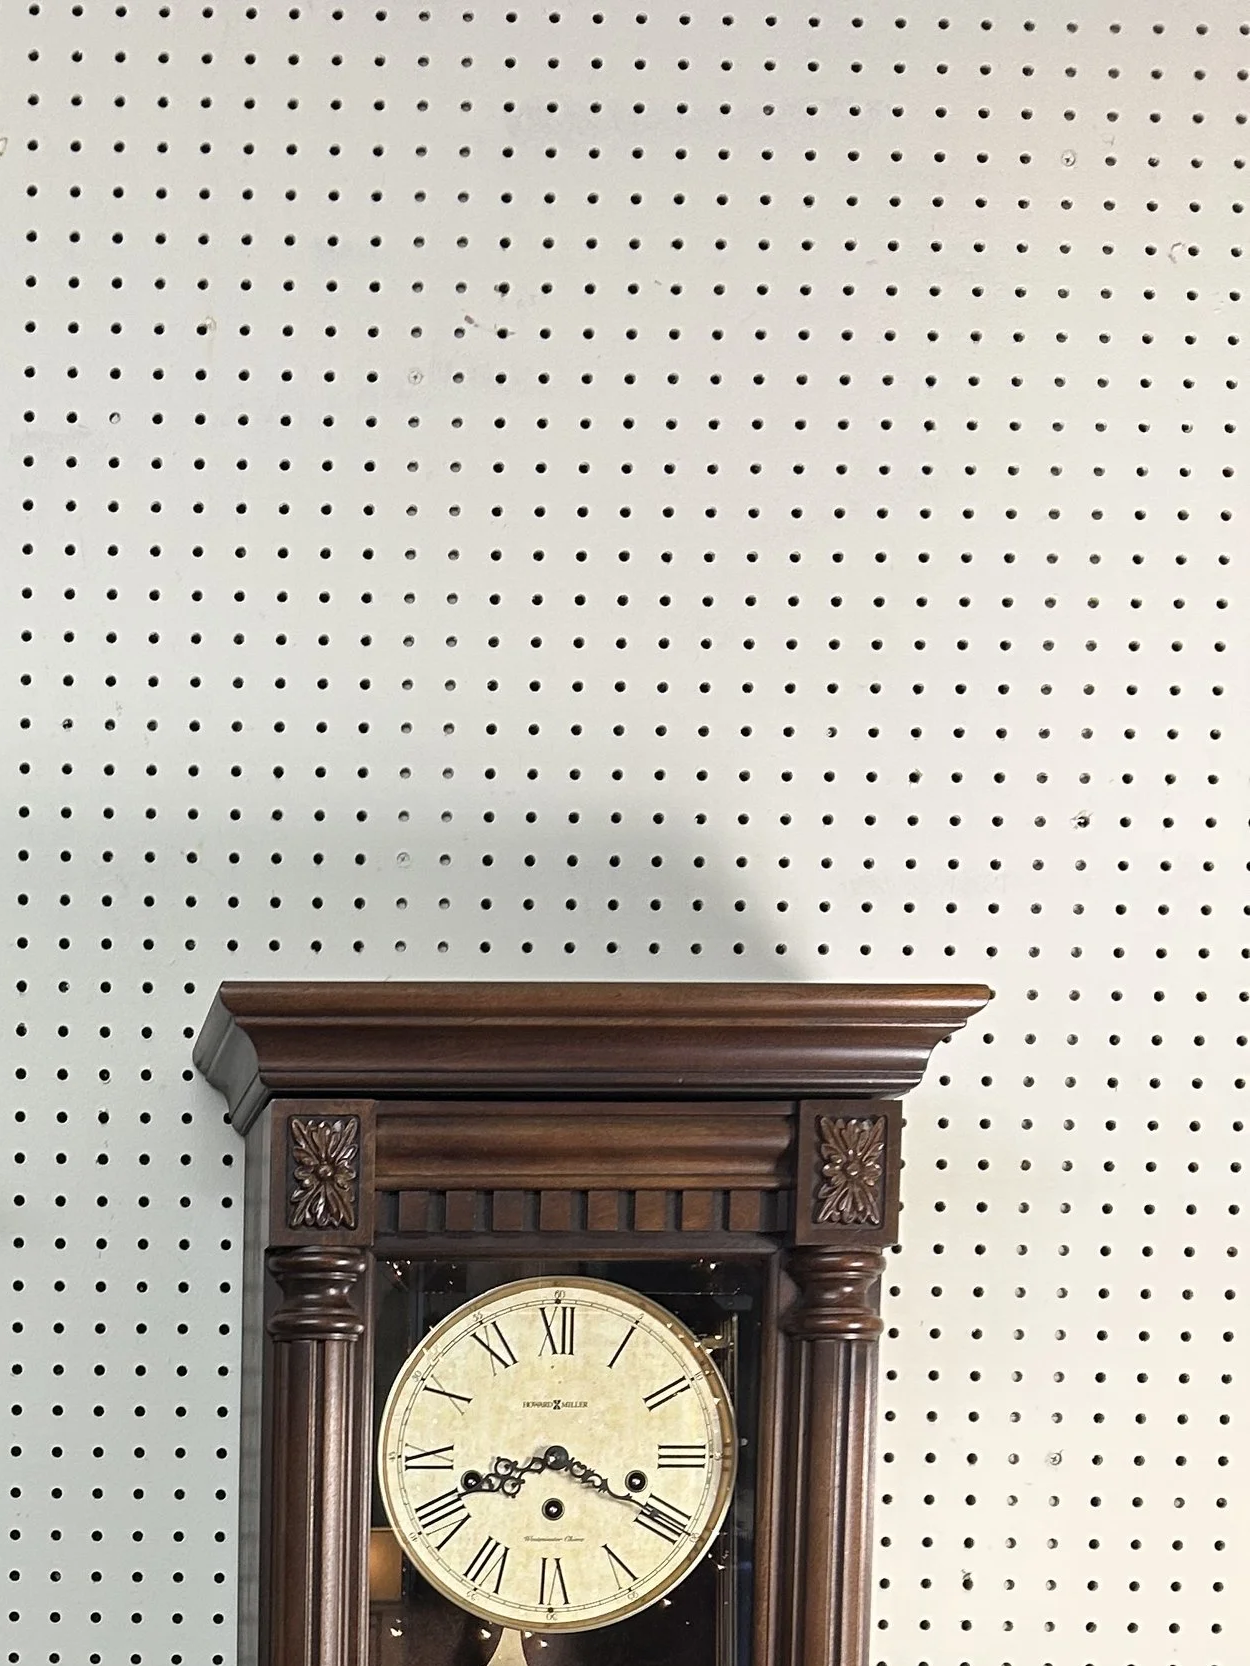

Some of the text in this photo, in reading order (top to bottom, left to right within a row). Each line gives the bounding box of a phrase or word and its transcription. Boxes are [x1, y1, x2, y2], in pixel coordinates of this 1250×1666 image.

[538, 1306, 576, 1357] XII
[657, 1444, 707, 1469] III
[538, 1557, 571, 1606] VI
